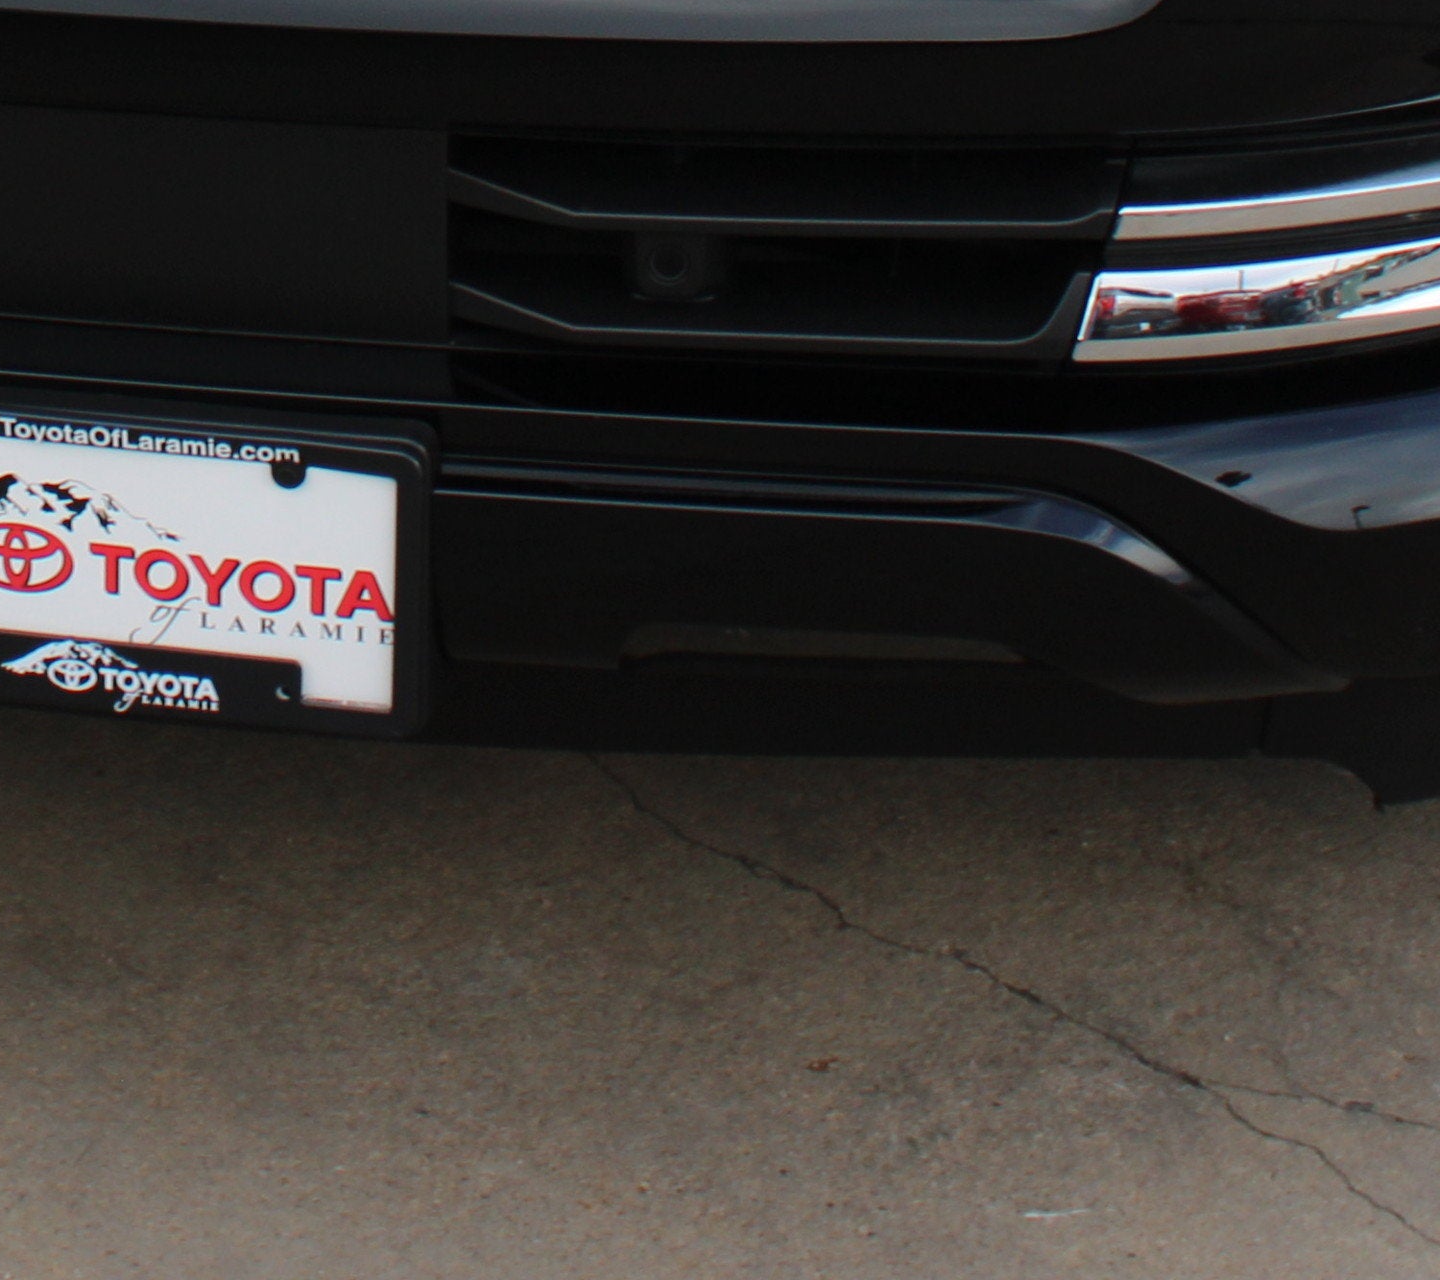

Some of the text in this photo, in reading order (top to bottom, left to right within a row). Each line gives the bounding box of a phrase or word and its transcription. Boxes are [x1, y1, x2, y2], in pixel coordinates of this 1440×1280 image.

[89, 542, 395, 623] TOYOTA
[130, 596, 395, 646] of LARAMIE
[98, 667, 220, 702] TOYOTA
[113, 688, 220, 713] of LARAMIE
